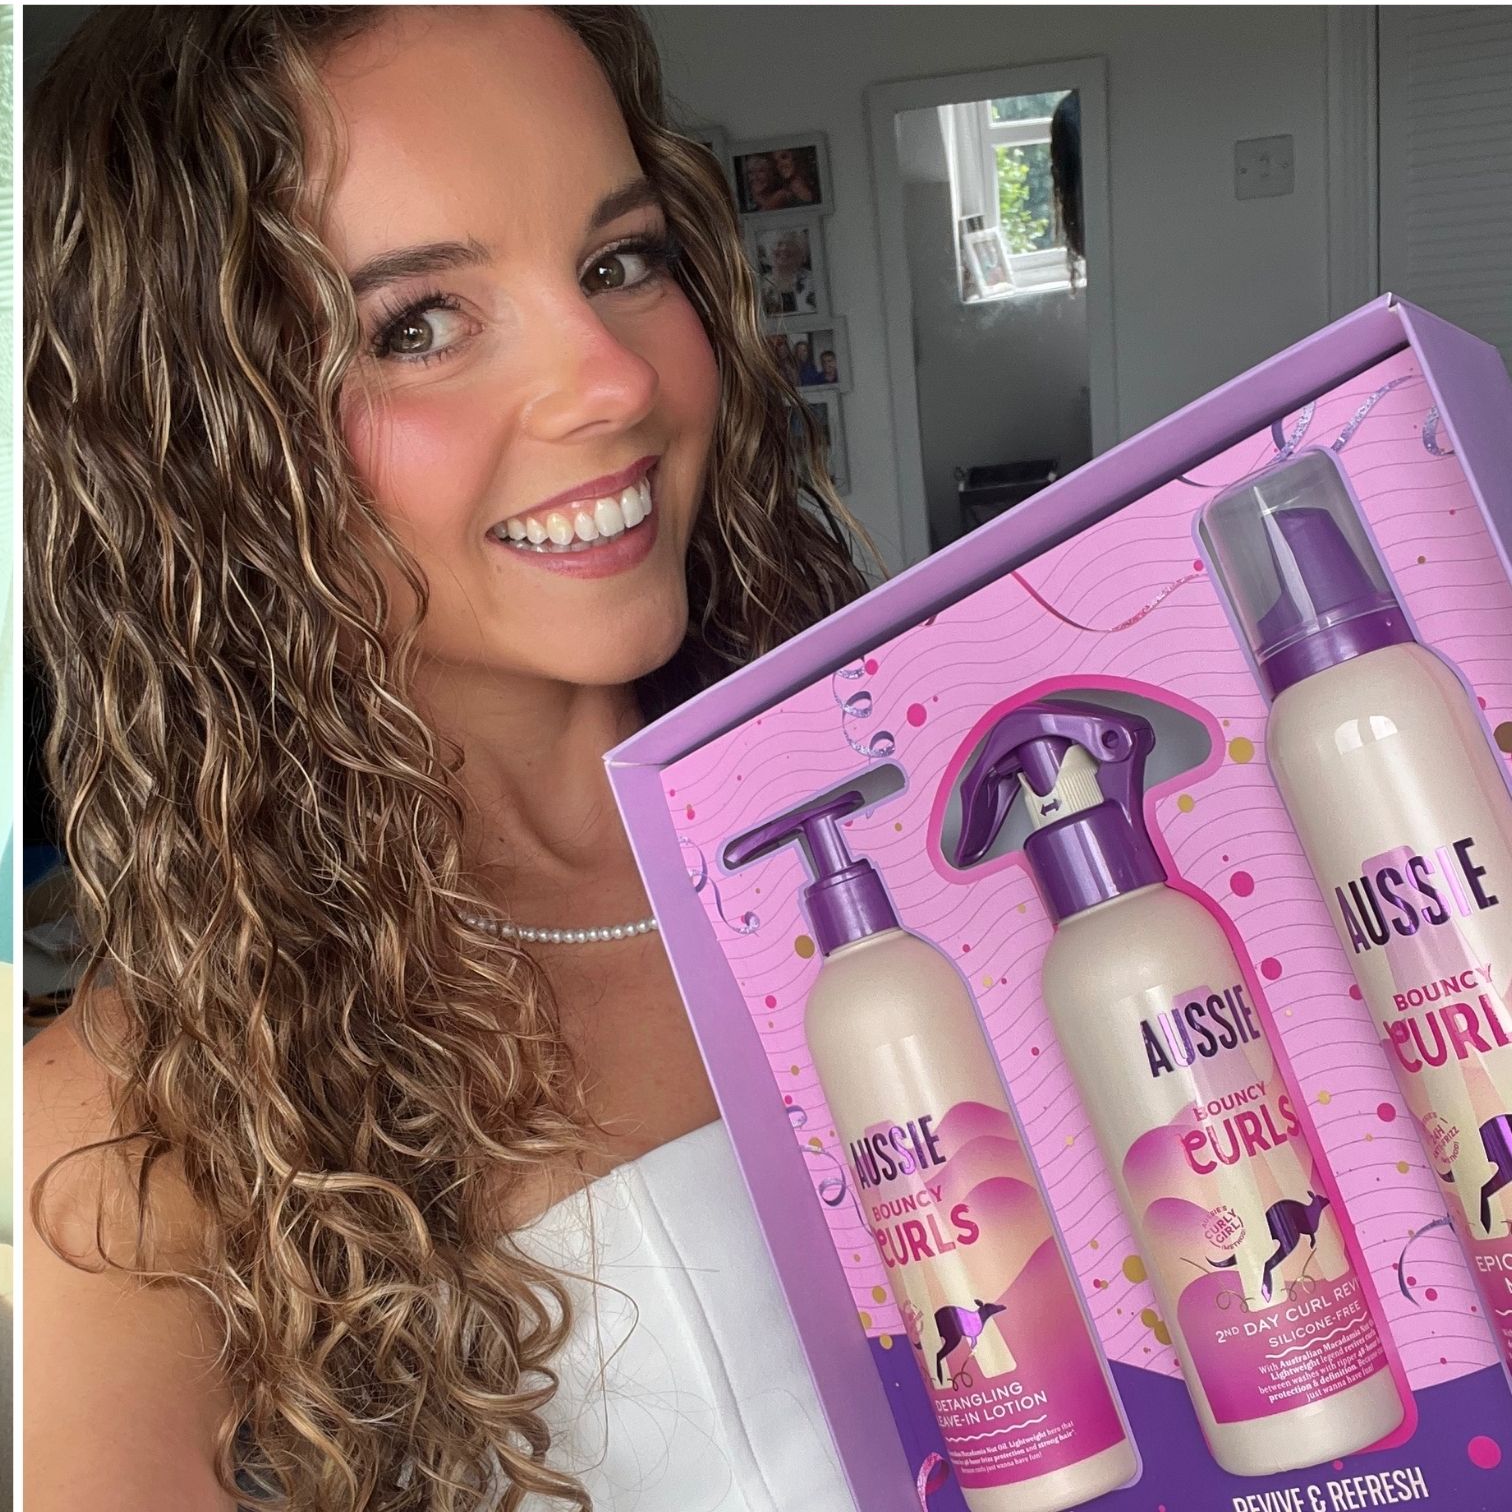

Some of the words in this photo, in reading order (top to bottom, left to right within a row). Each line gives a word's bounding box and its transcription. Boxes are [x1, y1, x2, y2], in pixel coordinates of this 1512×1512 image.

[1335, 837, 1499, 954] AUSSIE
[1393, 963, 1492, 1011] BOUNCY
[1140, 984, 1260, 1078] AUSSIE
[1383, 994, 1512, 1073] CURL
[1193, 1081, 1267, 1121] BOUNCY
[850, 1115, 946, 1189] AUSSIE
[1181, 1093, 1300, 1175] CURLS
[872, 1185, 942, 1221] BOUNCY
[1205, 1208, 1236, 1239] CURLY
[870, 1204, 979, 1268] CURLS
[1216, 1222, 1240, 1243] GIRL
[1216, 1327, 1239, 1343] 2ND
[1244, 1314, 1279, 1336] DAY
[1286, 1299, 1331, 1322] CURL
[1334, 1279, 1359, 1301] REVI
[1269, 1301, 1361, 1347] SILICONE-FREE
[1258, 1380, 1291, 1394] between
[1292, 1371, 1319, 1384] washes
[1320, 1362, 1336, 1373] with
[1337, 1353, 1357, 1368] ripper
[1259, 1363, 1278, 1374] With
[1280, 1348, 1323, 1368] Australian
[1323, 1331, 1361, 1352] Macadamia
[1270, 1358, 1320, 1381] Lightweight
[1320, 1348, 1344, 1363] legend
[1344, 1336, 1365, 1352] revives
[936, 1382, 1022, 1412] DETANGLING
[1269, 1383, 1312, 1403] protection
[1320, 1364, 1357, 1384] definition.
[1306, 1389, 1323, 1402] just
[1323, 1380, 1347, 1394] wanna
[1347, 1372, 1362, 1383] have
[984, 1390, 1048, 1421] LOTION
[994, 1449, 1025, 1463] protection
[1026, 1444, 1037, 1453] and
[1038, 1435, 1059, 1448] strong
[1009, 1430, 1046, 1448] Lightweight
[1047, 1426, 1060, 1435] hero
[1061, 1421, 1074, 1429] that
[985, 1464, 996, 1473] just
[996, 1460, 1014, 1469] wanna
[1014, 1456, 1028, 1464] have
[1029, 1452, 1042, 1461] fun!
[1307, 1485, 1326, 1512] &
[1326, 1466, 1430, 1512] REFRESH
